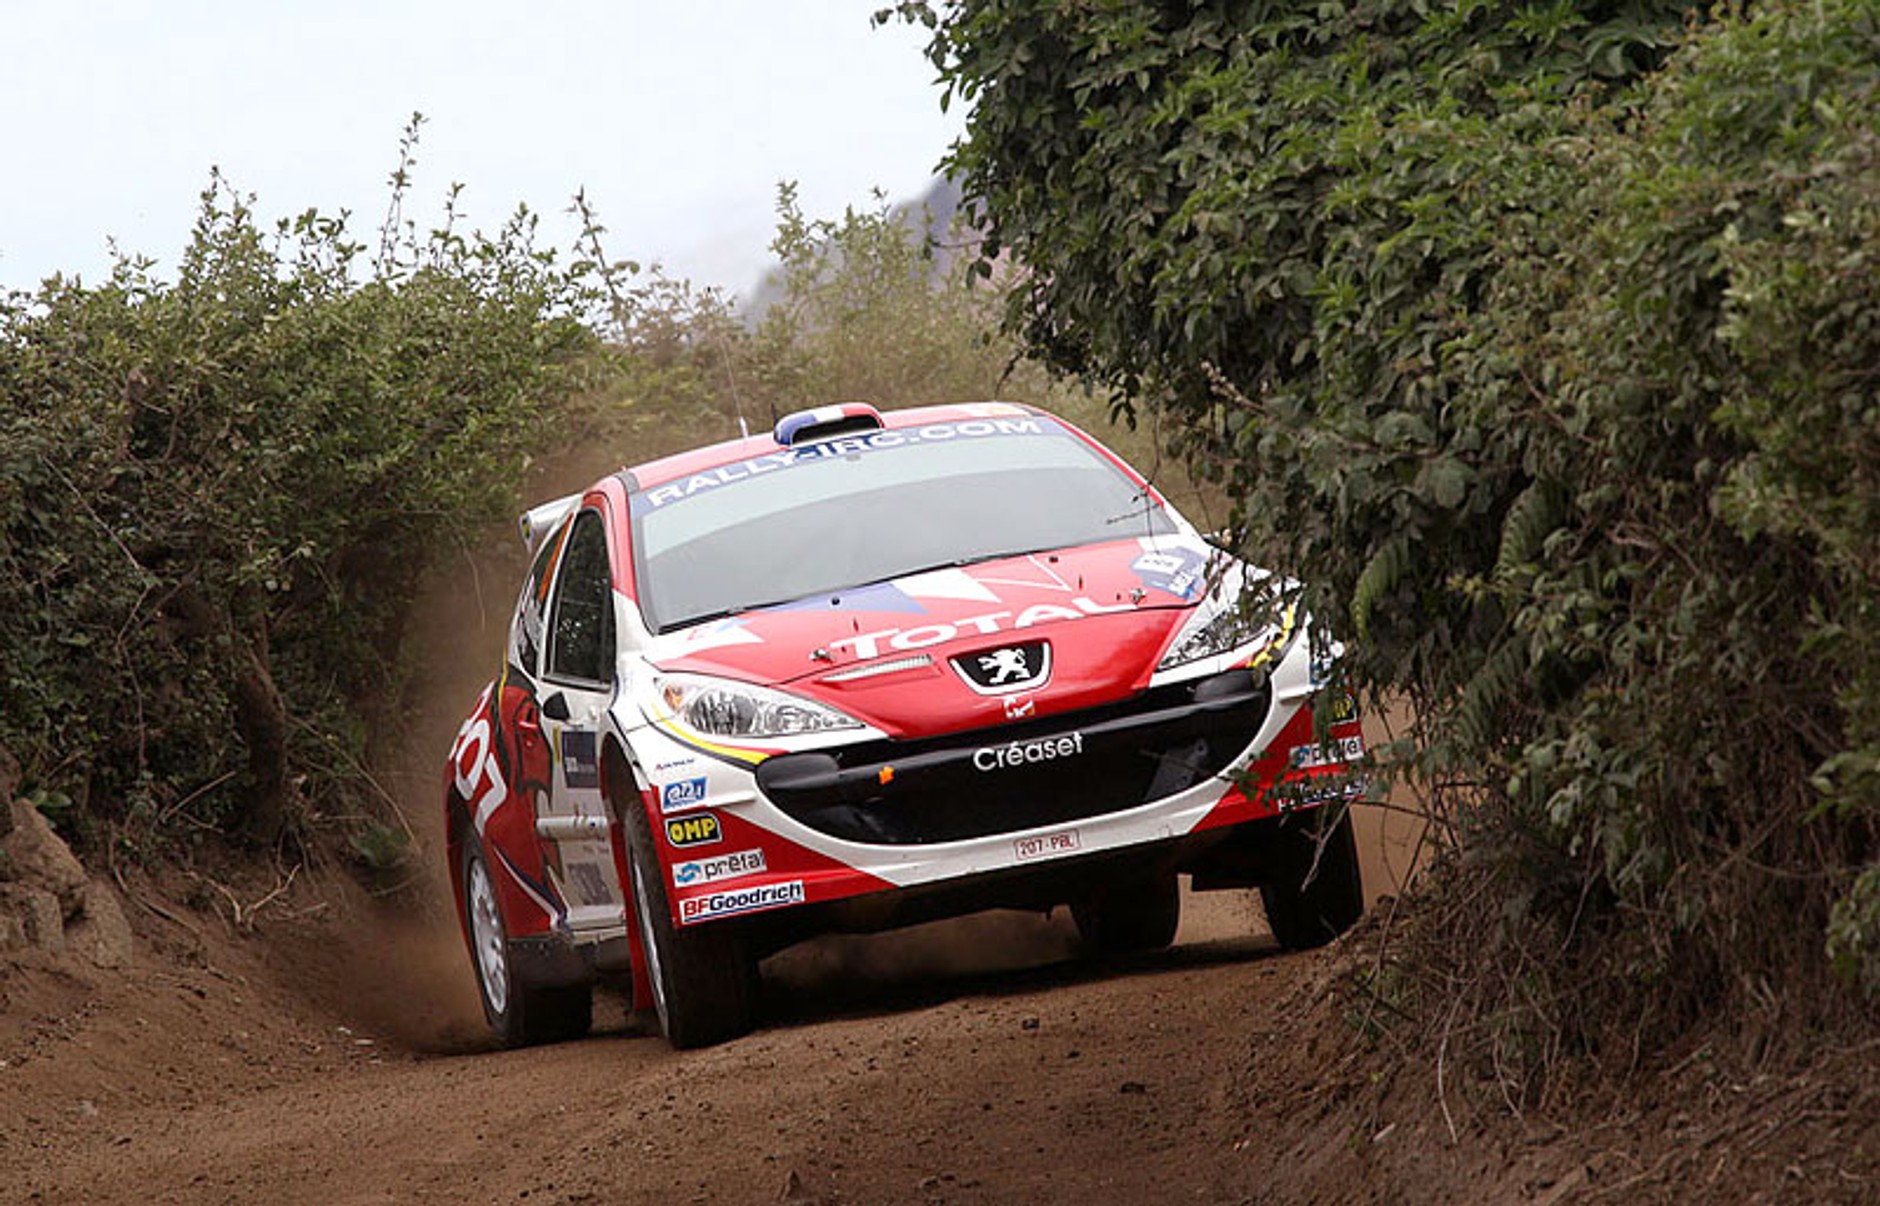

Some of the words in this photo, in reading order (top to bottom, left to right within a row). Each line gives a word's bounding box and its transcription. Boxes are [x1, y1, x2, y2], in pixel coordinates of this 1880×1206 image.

[647, 419, 1044, 507] RALLY-IRC.COM
[832, 597, 1138, 658] TOTAL
[973, 731, 1083, 772] Créaset
[669, 817, 717, 843] OMP
[683, 883, 803, 917] BFGoodrich
